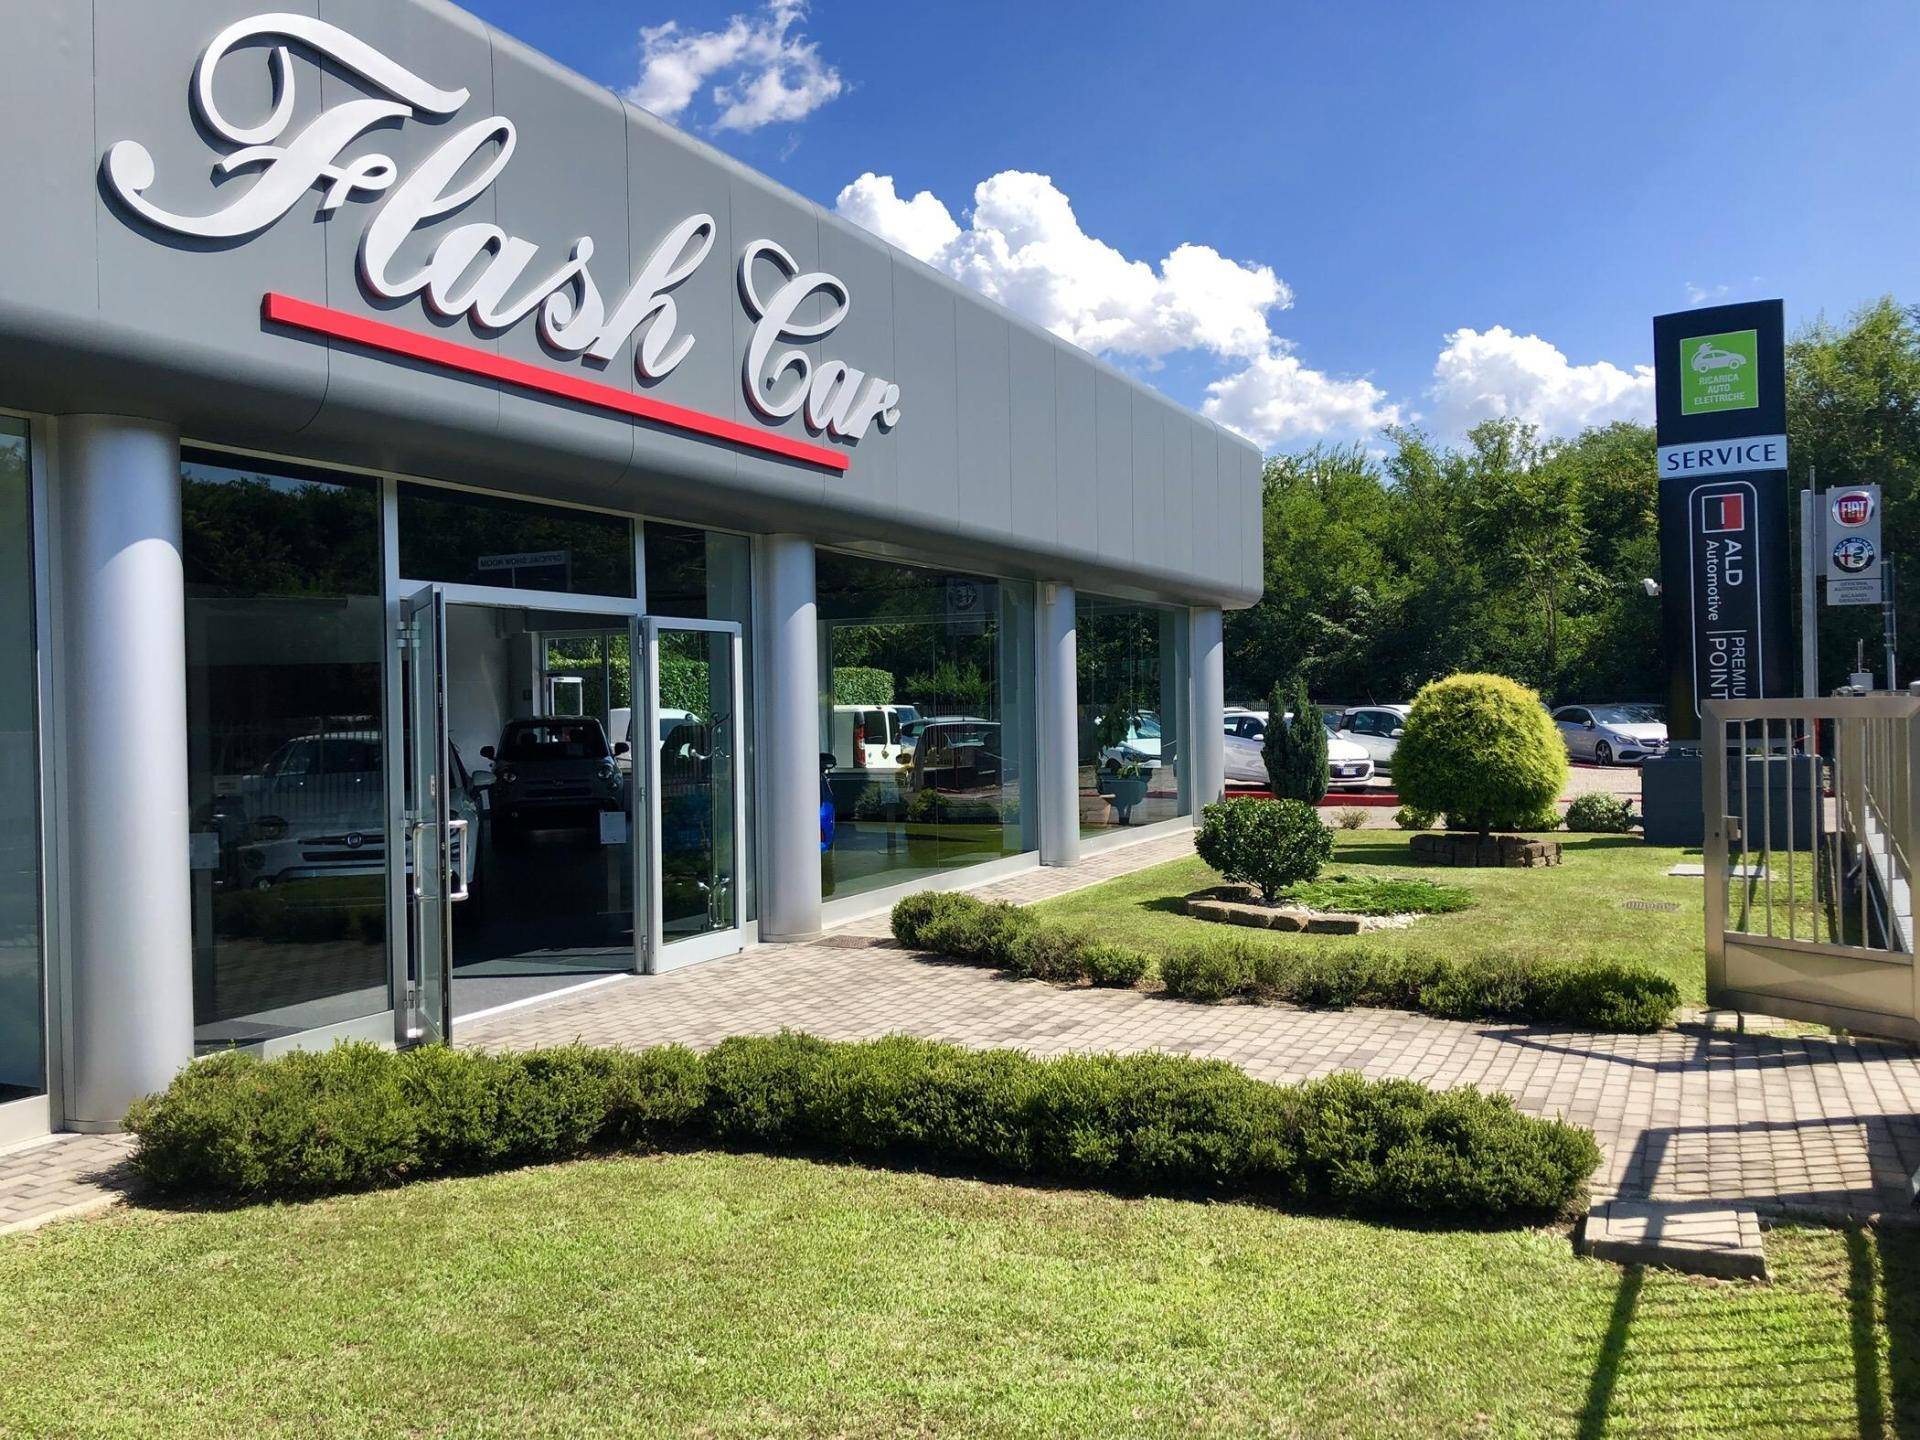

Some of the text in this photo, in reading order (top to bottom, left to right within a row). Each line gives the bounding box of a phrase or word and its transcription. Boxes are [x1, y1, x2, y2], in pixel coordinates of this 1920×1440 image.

[102, 11, 901, 440] Flash Car
[1698, 374, 1739, 384] RICARICA
[1707, 383, 1730, 394] AUTO
[1694, 392, 1745, 405] ELETTRICHE
[1667, 443, 1776, 471] SERVICE
[1840, 500, 1867, 518] FIAT
[1705, 540, 1720, 621] Automotive
[1724, 538, 1743, 586] ALD
[1709, 637, 1729, 700] POINT
[1731, 637, 1747, 701] PREMIU
